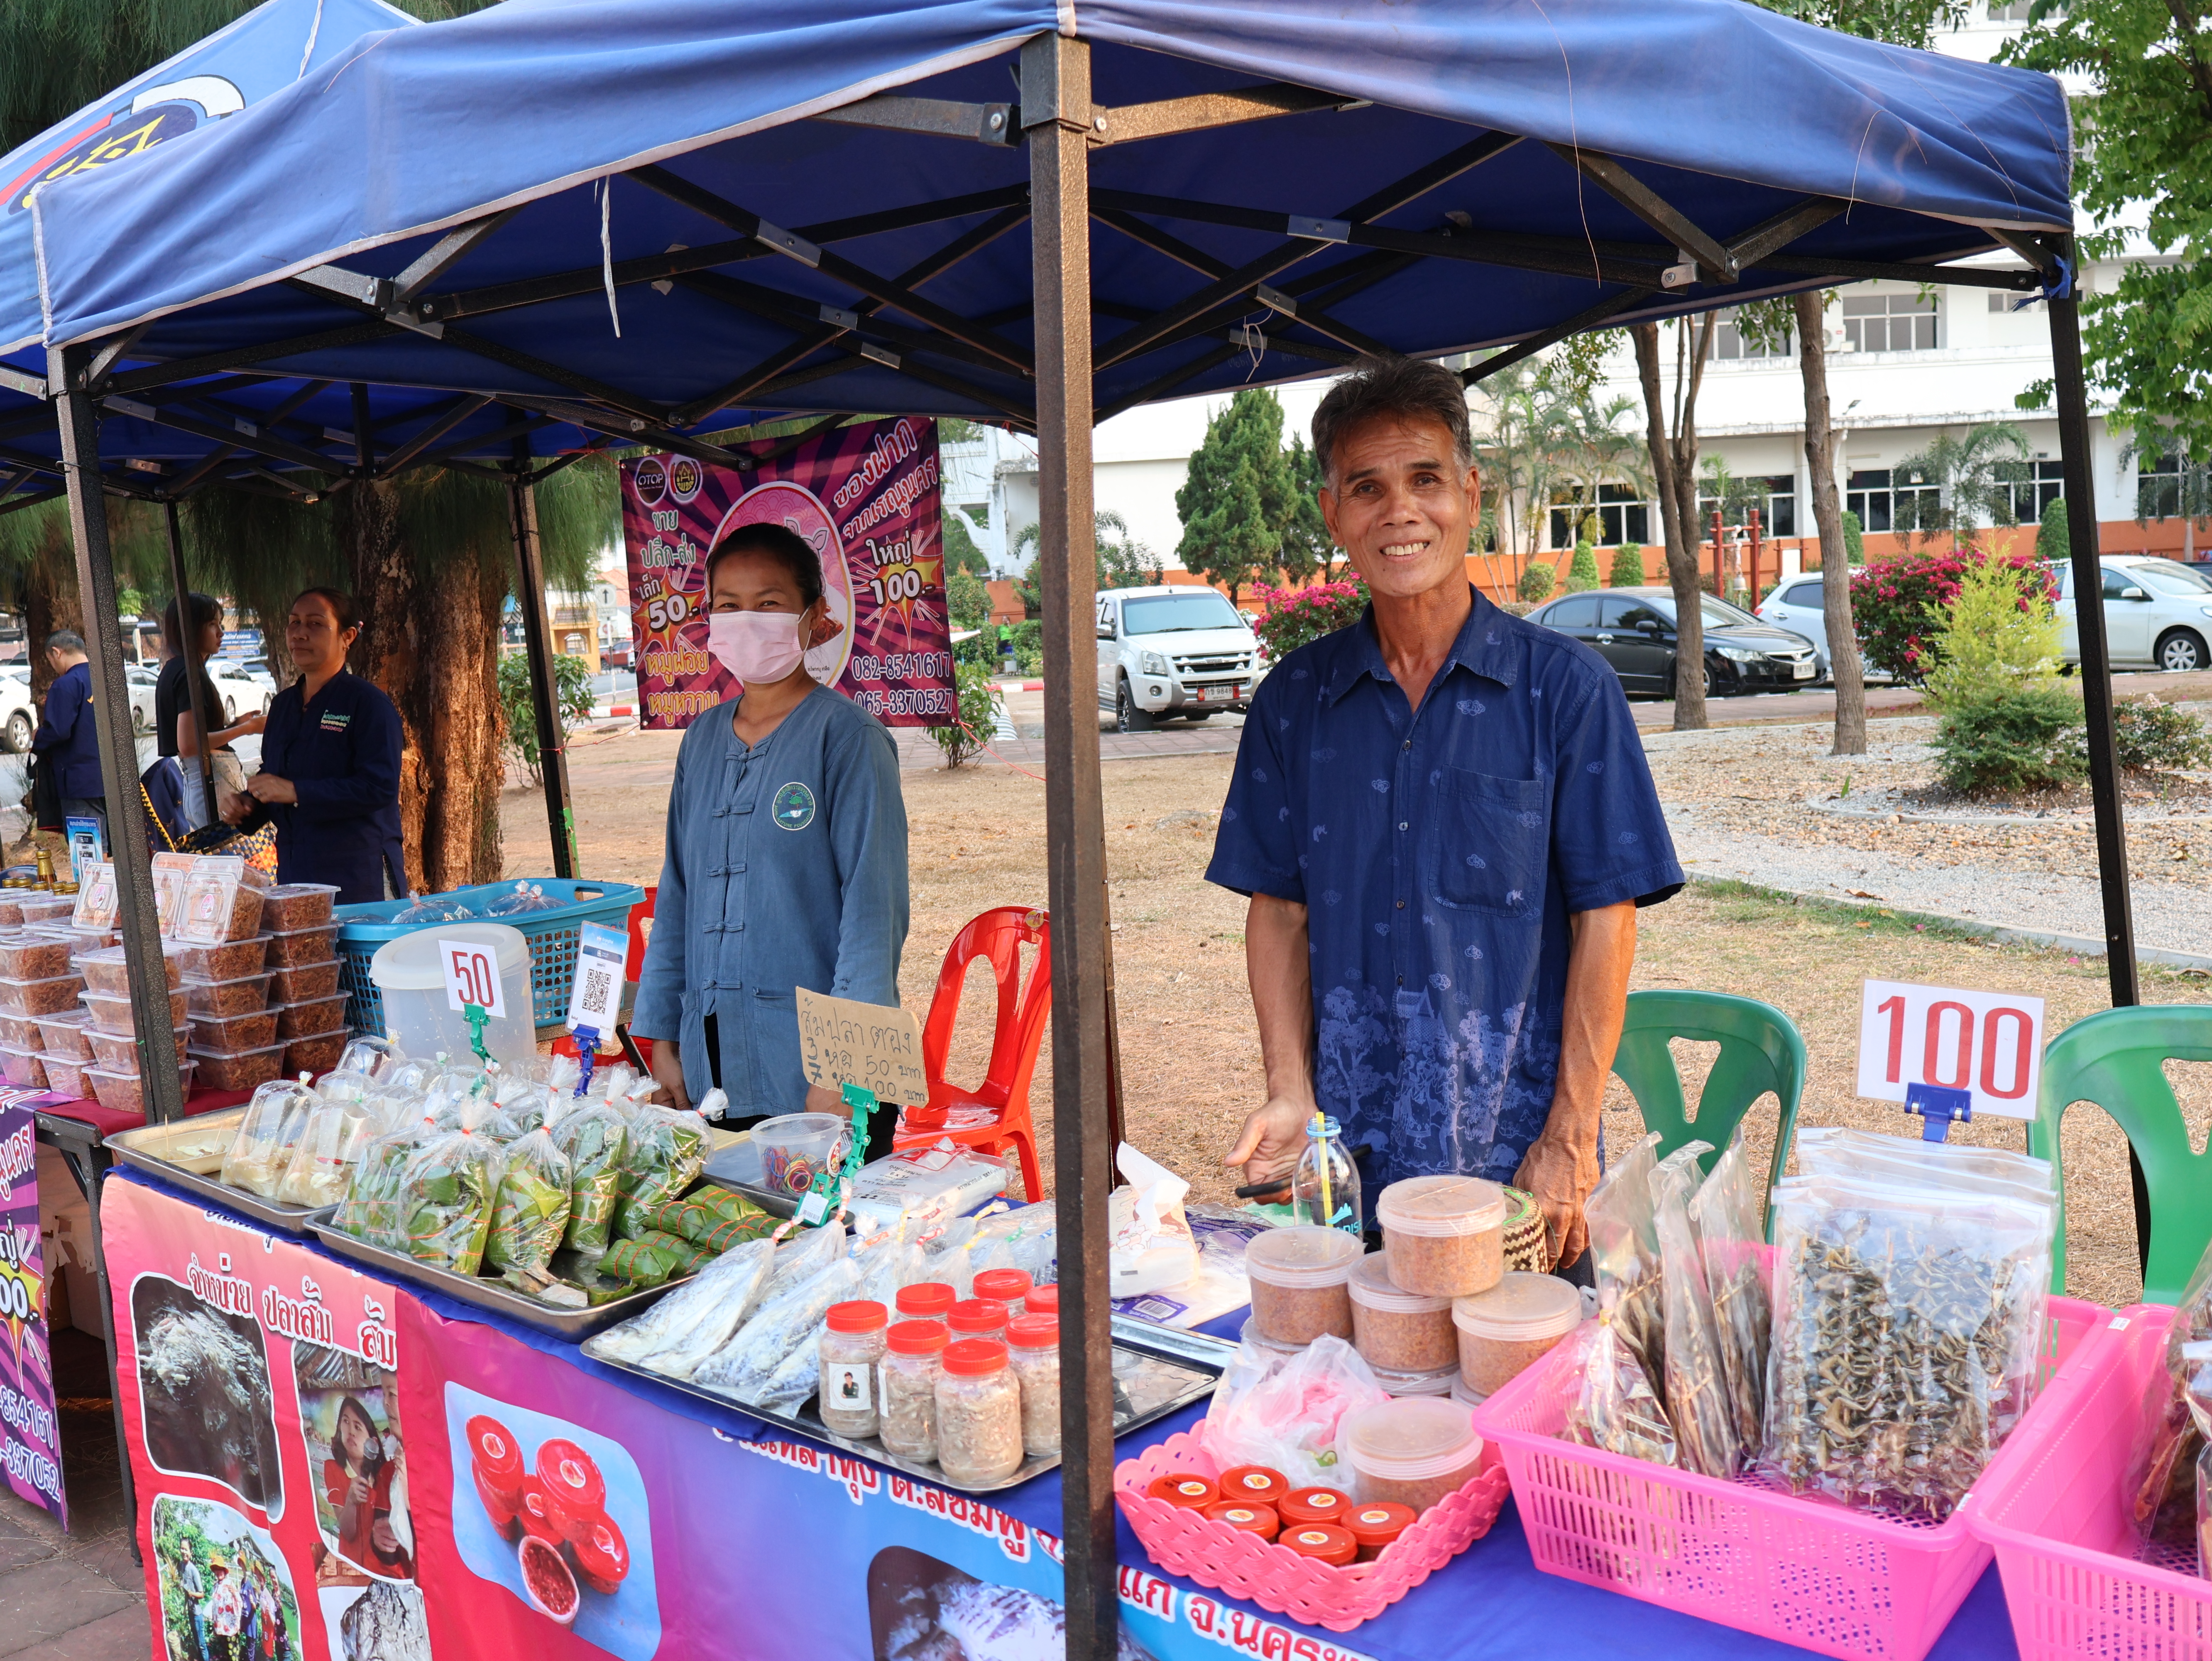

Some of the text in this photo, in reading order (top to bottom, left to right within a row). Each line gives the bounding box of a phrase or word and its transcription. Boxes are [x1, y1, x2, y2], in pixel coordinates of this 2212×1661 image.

[638, 473, 663, 485] OTOP
[834, 419, 918, 508] ของฝาก
[843, 456, 937, 539] จากเรณูนคร
[652, 510, 678, 532] ขาย
[641, 533, 696, 568] ปลีก-ส่ง
[866, 527, 911, 566] ใหญ่
[638, 572, 661, 600] เล็ก
[870, 571, 932, 605] 100.-
[649, 594, 698, 629] 50.-
[645, 644, 709, 686] หมูฝอย
[852, 652, 950, 681] 082-8541617
[647, 690, 719, 726] หมูหวาน
[854, 688, 953, 716] 065-3370527
[794, 808, 813, 828] FOUNDATION
[452, 951, 494, 1007] 50
[807, 1037, 818, 1060] 3
[866, 1055, 889, 1076] 50
[898, 1065, 921, 1079] บาท
[1877, 995, 2033, 1100] 100
[808, 1062, 822, 1084] 7
[864, 1077, 896, 1097] 100
[904, 1089, 925, 1101] บาท
[262, 1276, 333, 1349] ปลาส้ม
[359, 1295, 397, 1370] ส้ม
[0, 1385, 54, 1449] 854161
[1188, 1594, 1366, 1661] จ.นคร
